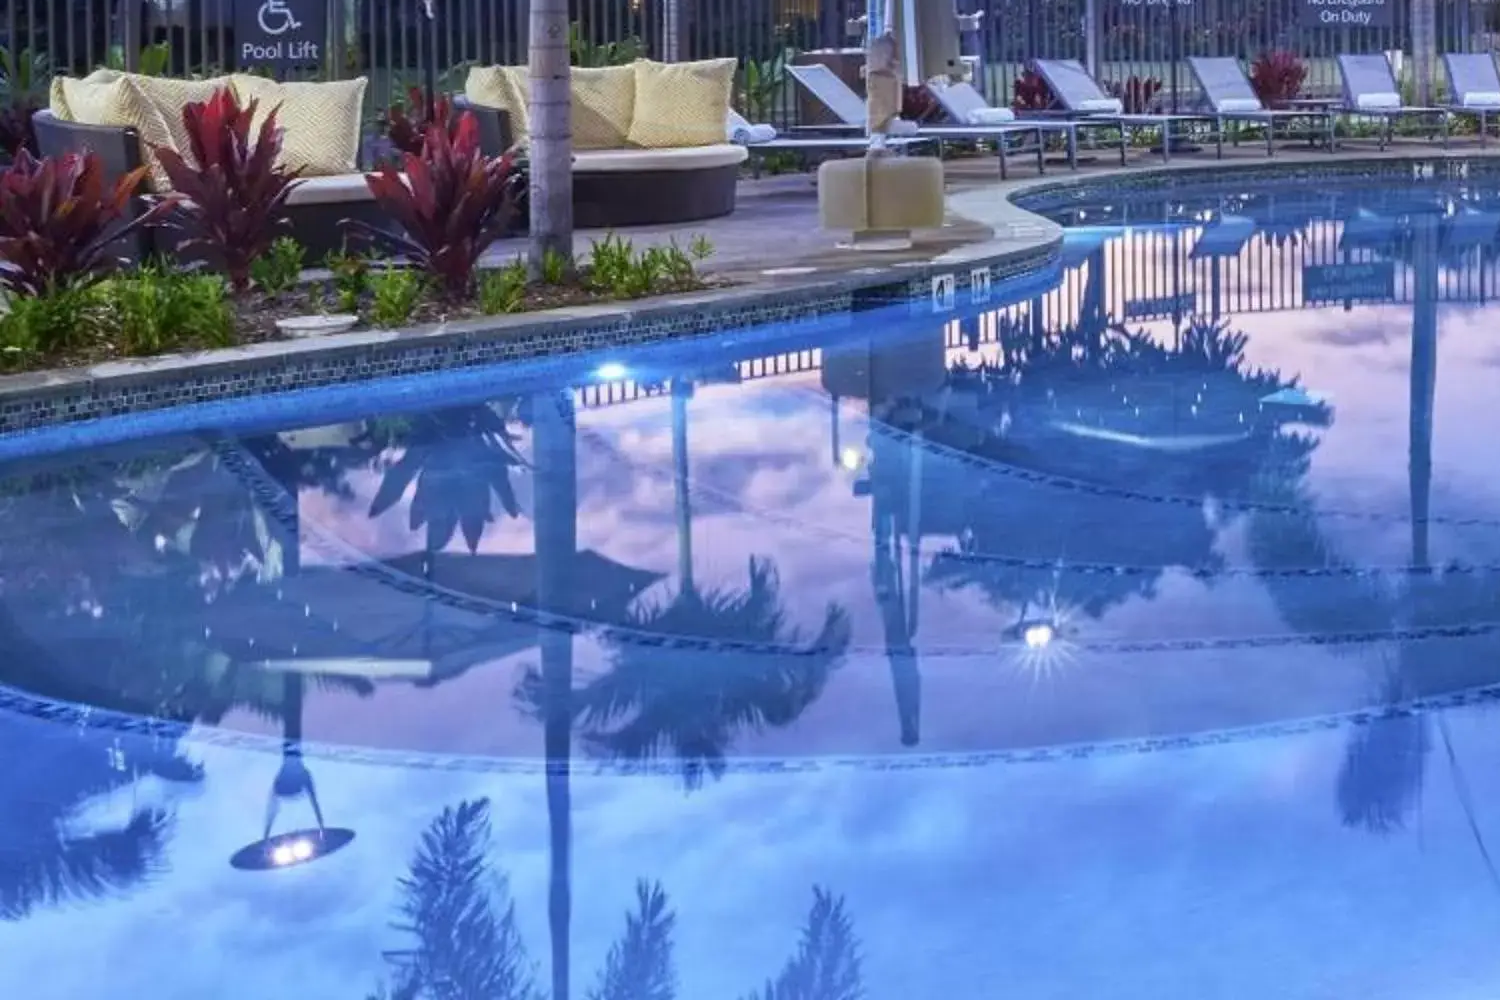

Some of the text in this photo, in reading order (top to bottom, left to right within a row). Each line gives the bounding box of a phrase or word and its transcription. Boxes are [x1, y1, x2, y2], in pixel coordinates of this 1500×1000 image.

[1320, 9, 1371, 25] On Duty
[242, 40, 319, 60] Pool Lift
